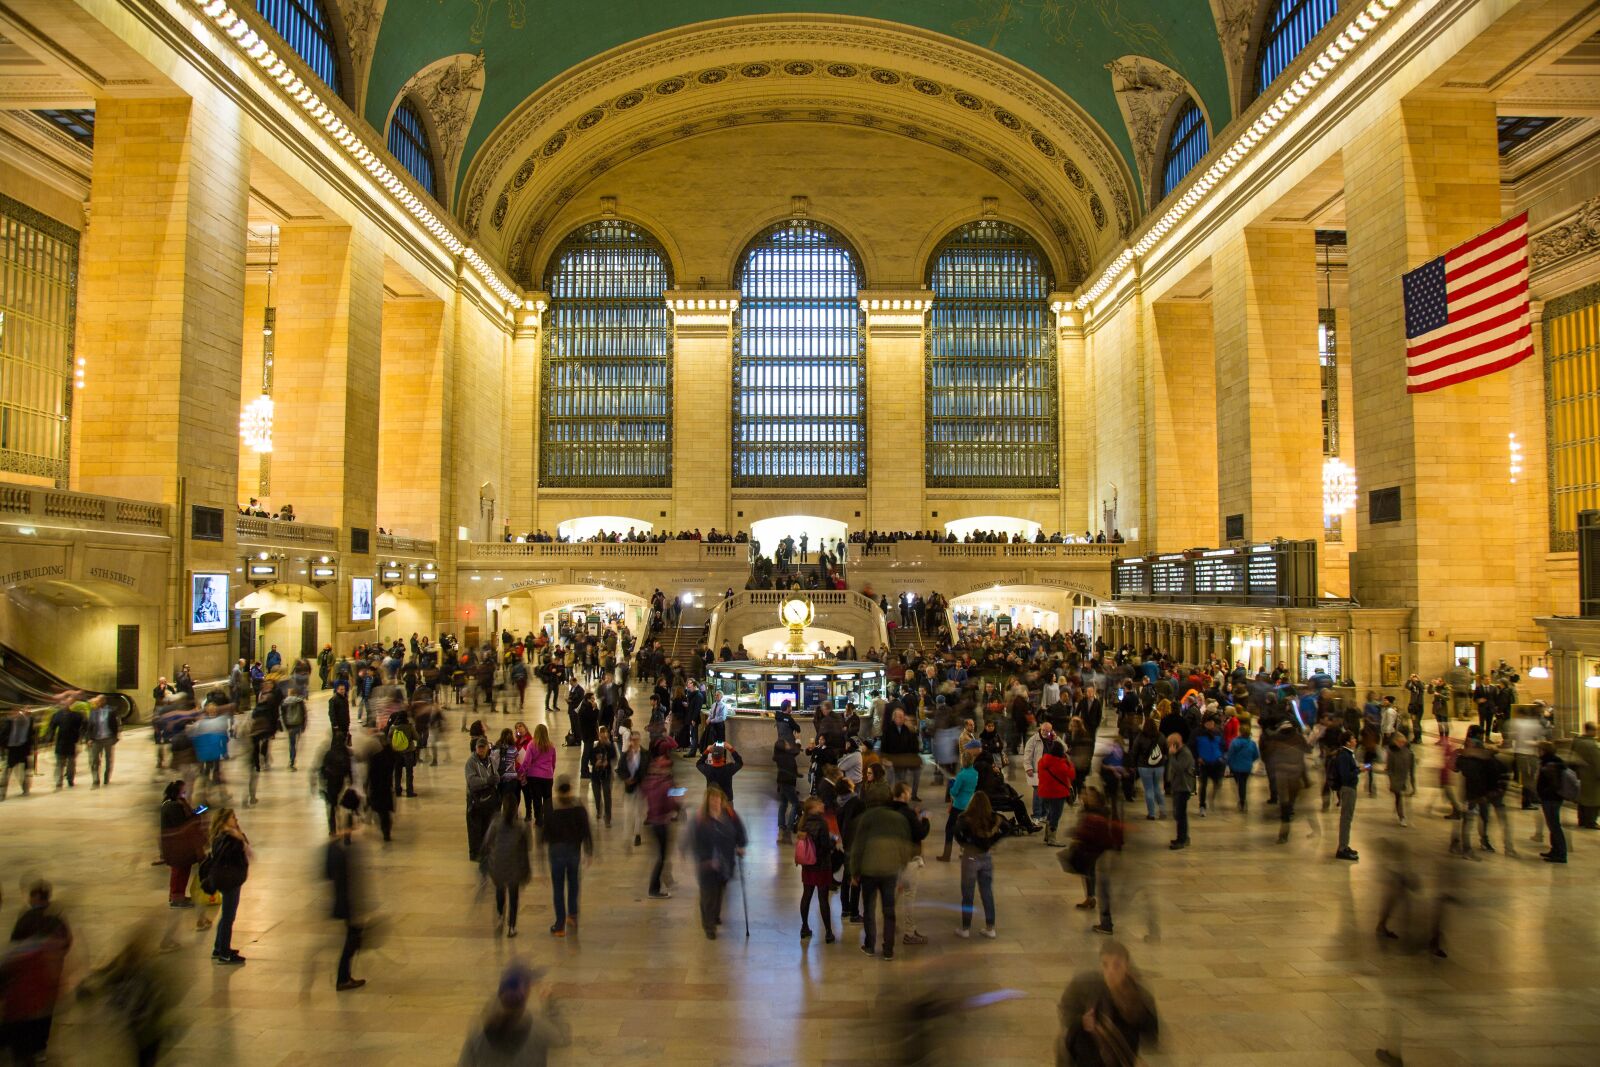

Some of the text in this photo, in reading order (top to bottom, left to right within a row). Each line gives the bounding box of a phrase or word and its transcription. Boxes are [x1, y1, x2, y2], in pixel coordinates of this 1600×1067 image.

[23, 565, 65, 580] BUILDING
[89, 567, 136, 586] 45TH STREET
[511, 580, 535, 589] TRACKS
[577, 577, 613, 587] LEXINGTON
[969, 579, 1006, 591] LEXINGTON
[1064, 580, 1095, 591] MACHINES
